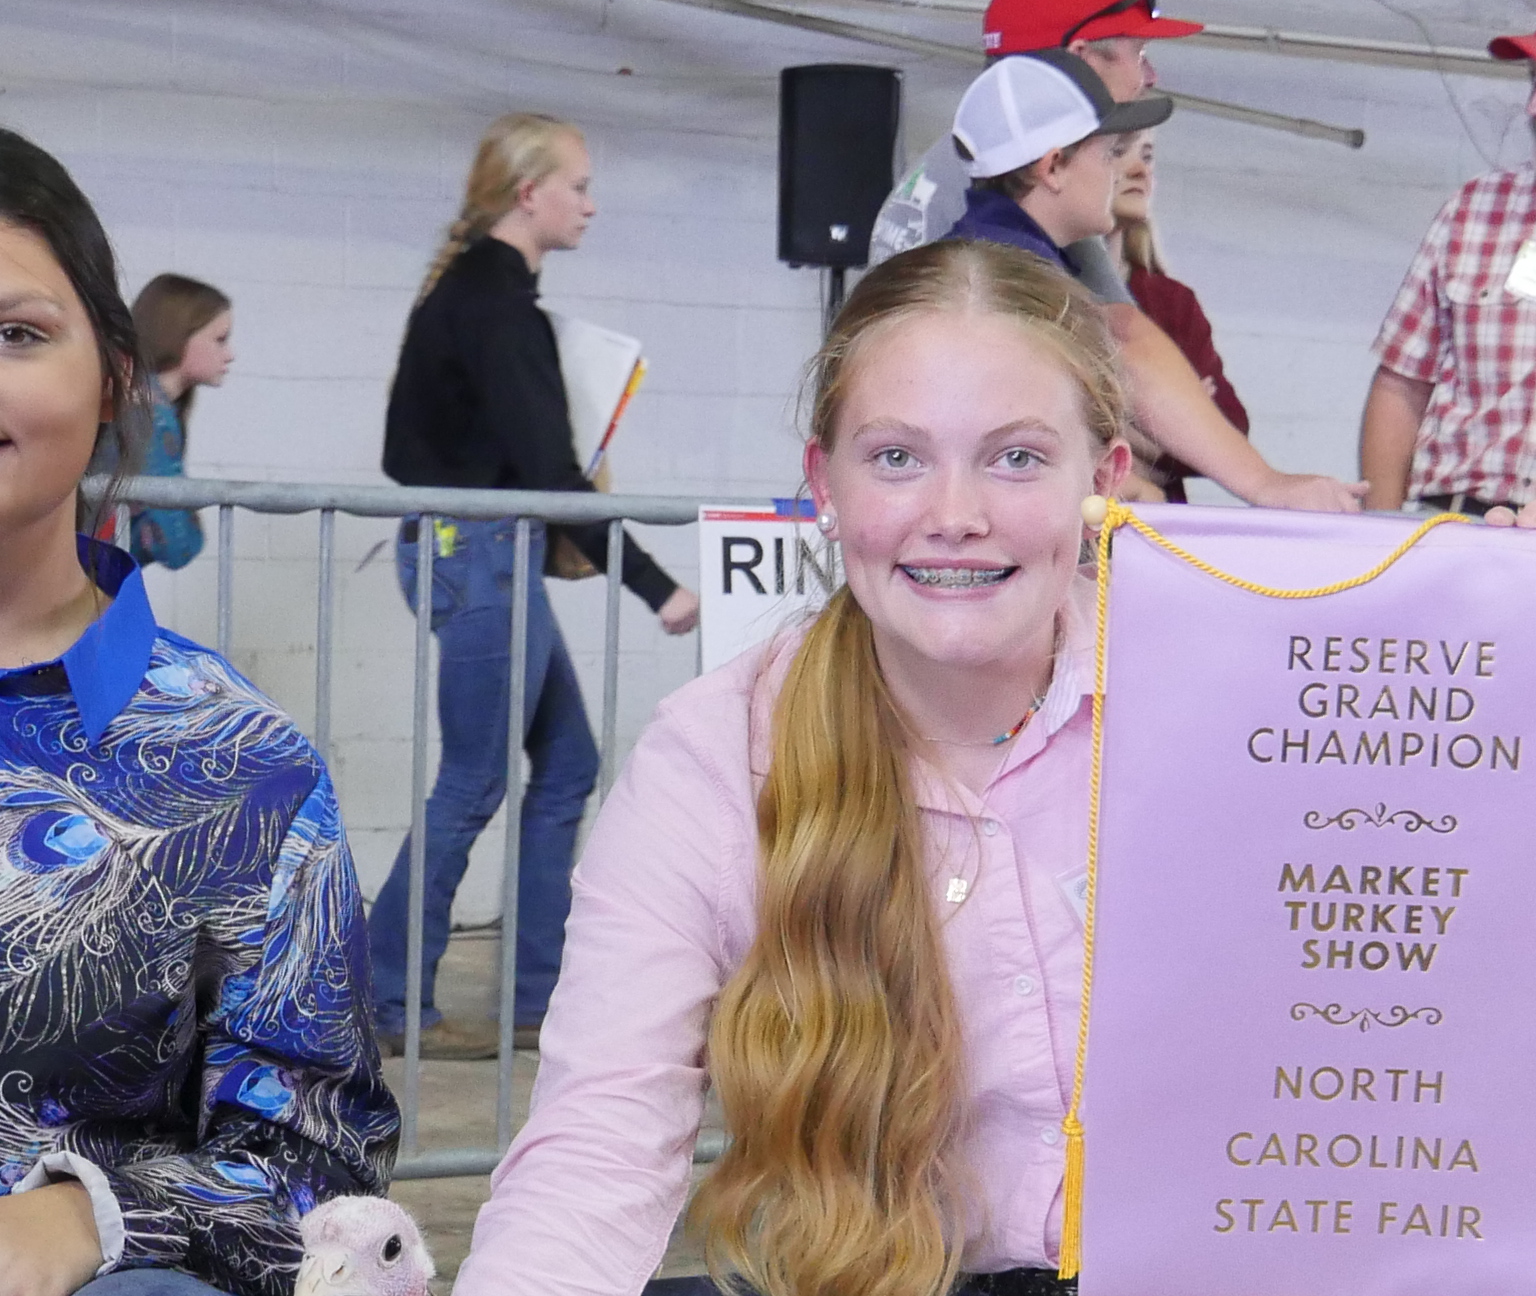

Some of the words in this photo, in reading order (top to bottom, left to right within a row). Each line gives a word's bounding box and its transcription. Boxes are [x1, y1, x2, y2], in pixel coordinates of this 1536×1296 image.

[722, 536, 836, 595] RIN
[1287, 635, 1497, 677] RESERVE
[1298, 682, 1475, 722] GRAND
[1247, 727, 1522, 772] CHAMPION
[1277, 863, 1470, 898] MARKET
[1284, 901, 1457, 935] TURKEY
[1300, 939, 1438, 973] SHOW
[1273, 1066, 1444, 1103] NORTH
[1225, 1131, 1479, 1173] CAROLINA
[1213, 1198, 1354, 1234] STATE
[1377, 1201, 1485, 1240] FAIR
